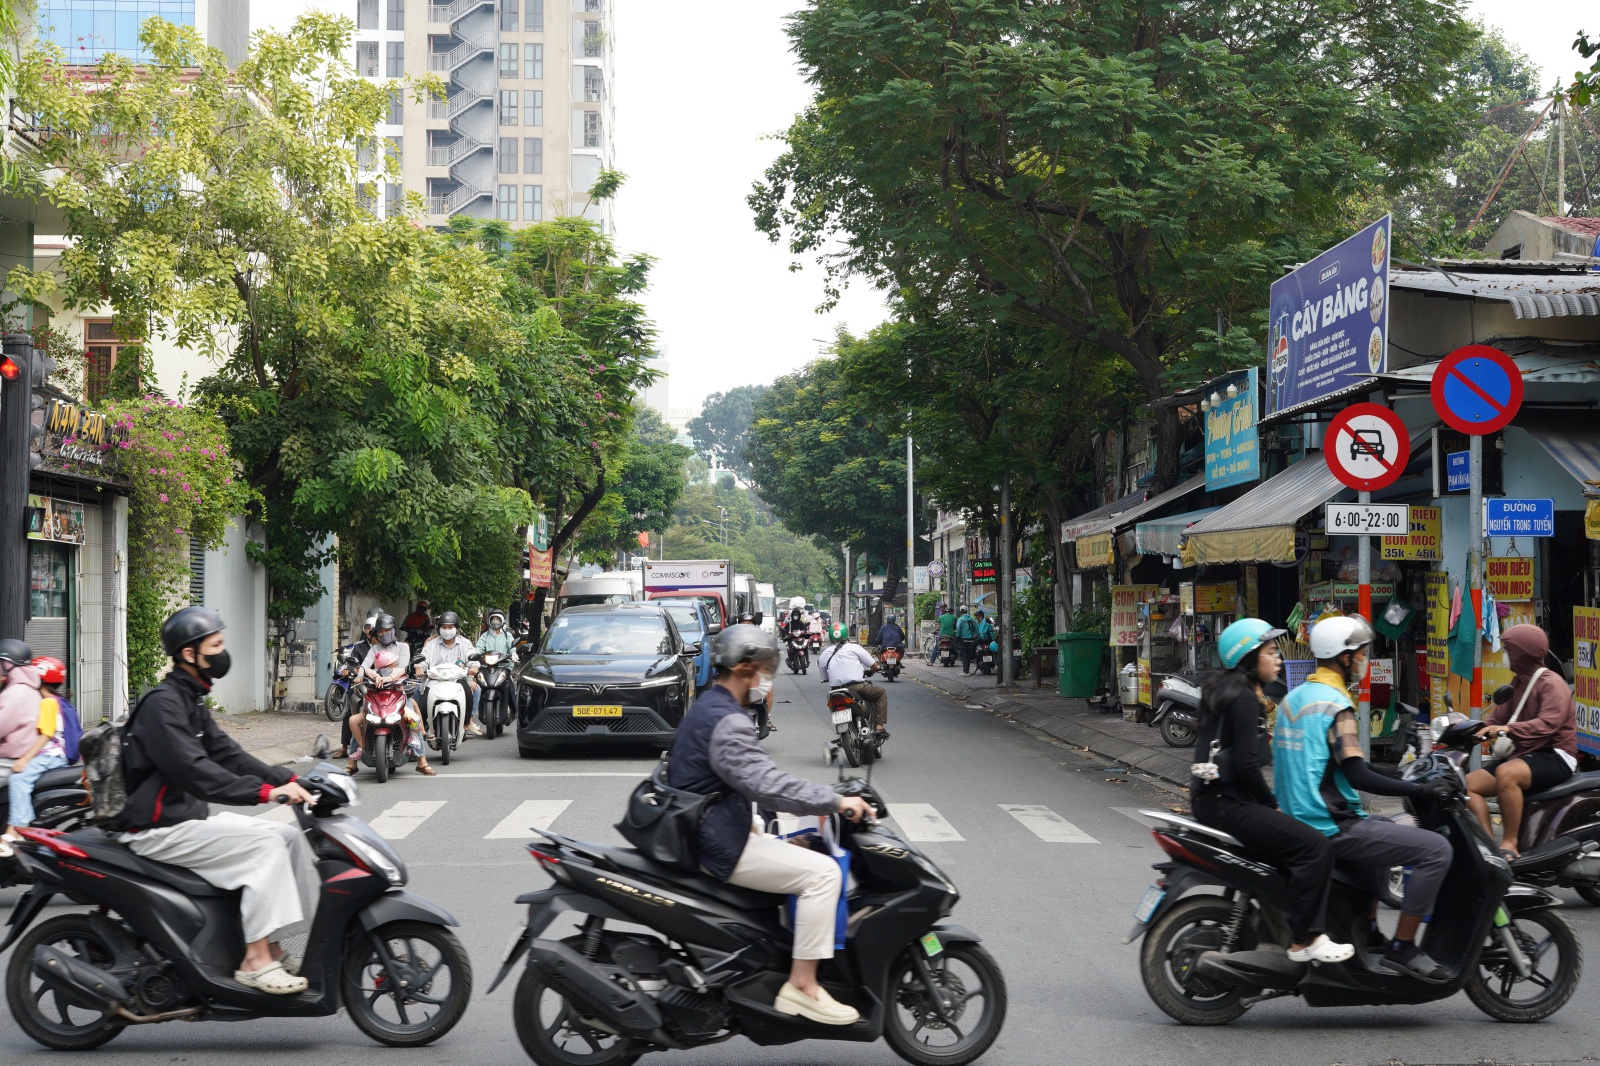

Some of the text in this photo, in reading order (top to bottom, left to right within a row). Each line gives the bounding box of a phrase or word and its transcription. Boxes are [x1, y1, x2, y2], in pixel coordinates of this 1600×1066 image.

[1292, 277, 1368, 341] CÂY BÀNG
[1276, 354, 1287, 365] PEPSI
[1503, 502, 1536, 512] ĐƯỜNG
[1409, 522, 1426, 531] 0k
[1490, 515, 1551, 532] NGUYỄN TRỌNG TUYỂN
[1385, 548, 1404, 558] 35k
[1489, 559, 1530, 576] BÚN RIÊU
[1115, 590, 1135, 606] CƠM
[1510, 581, 1531, 598] MỌC
[1114, 610, 1136, 629] BÚN THỊ
[1575, 610, 1599, 640] BÚN RIÊU
[1576, 670, 1586, 698] BÚN
